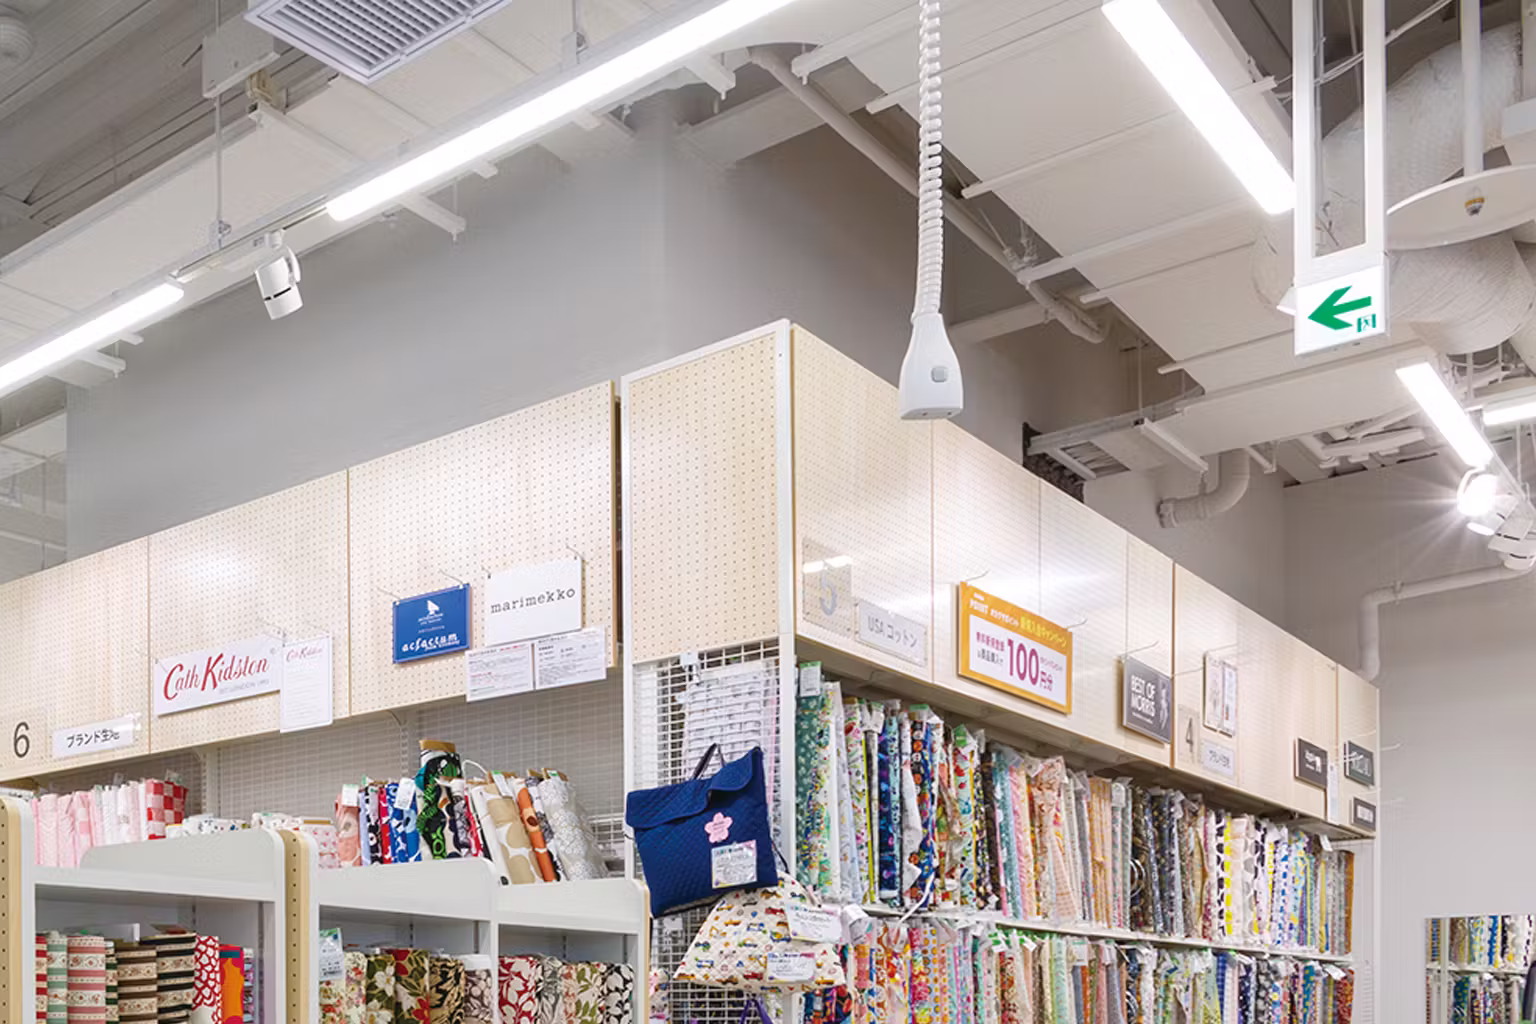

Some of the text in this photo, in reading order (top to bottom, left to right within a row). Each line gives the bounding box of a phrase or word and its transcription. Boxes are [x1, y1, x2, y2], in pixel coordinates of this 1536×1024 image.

[490, 587, 576, 614] marimekko
[867, 615, 918, 648] USA コットン
[164, 653, 270, 700] Cath Kidston
[1007, 637, 1039, 686] 100
[1130, 675, 1156, 700] BEST OF
[1130, 693, 1156, 717] MORRIS
[13, 721, 30, 758] 6
[1185, 716, 1195, 754] 4
